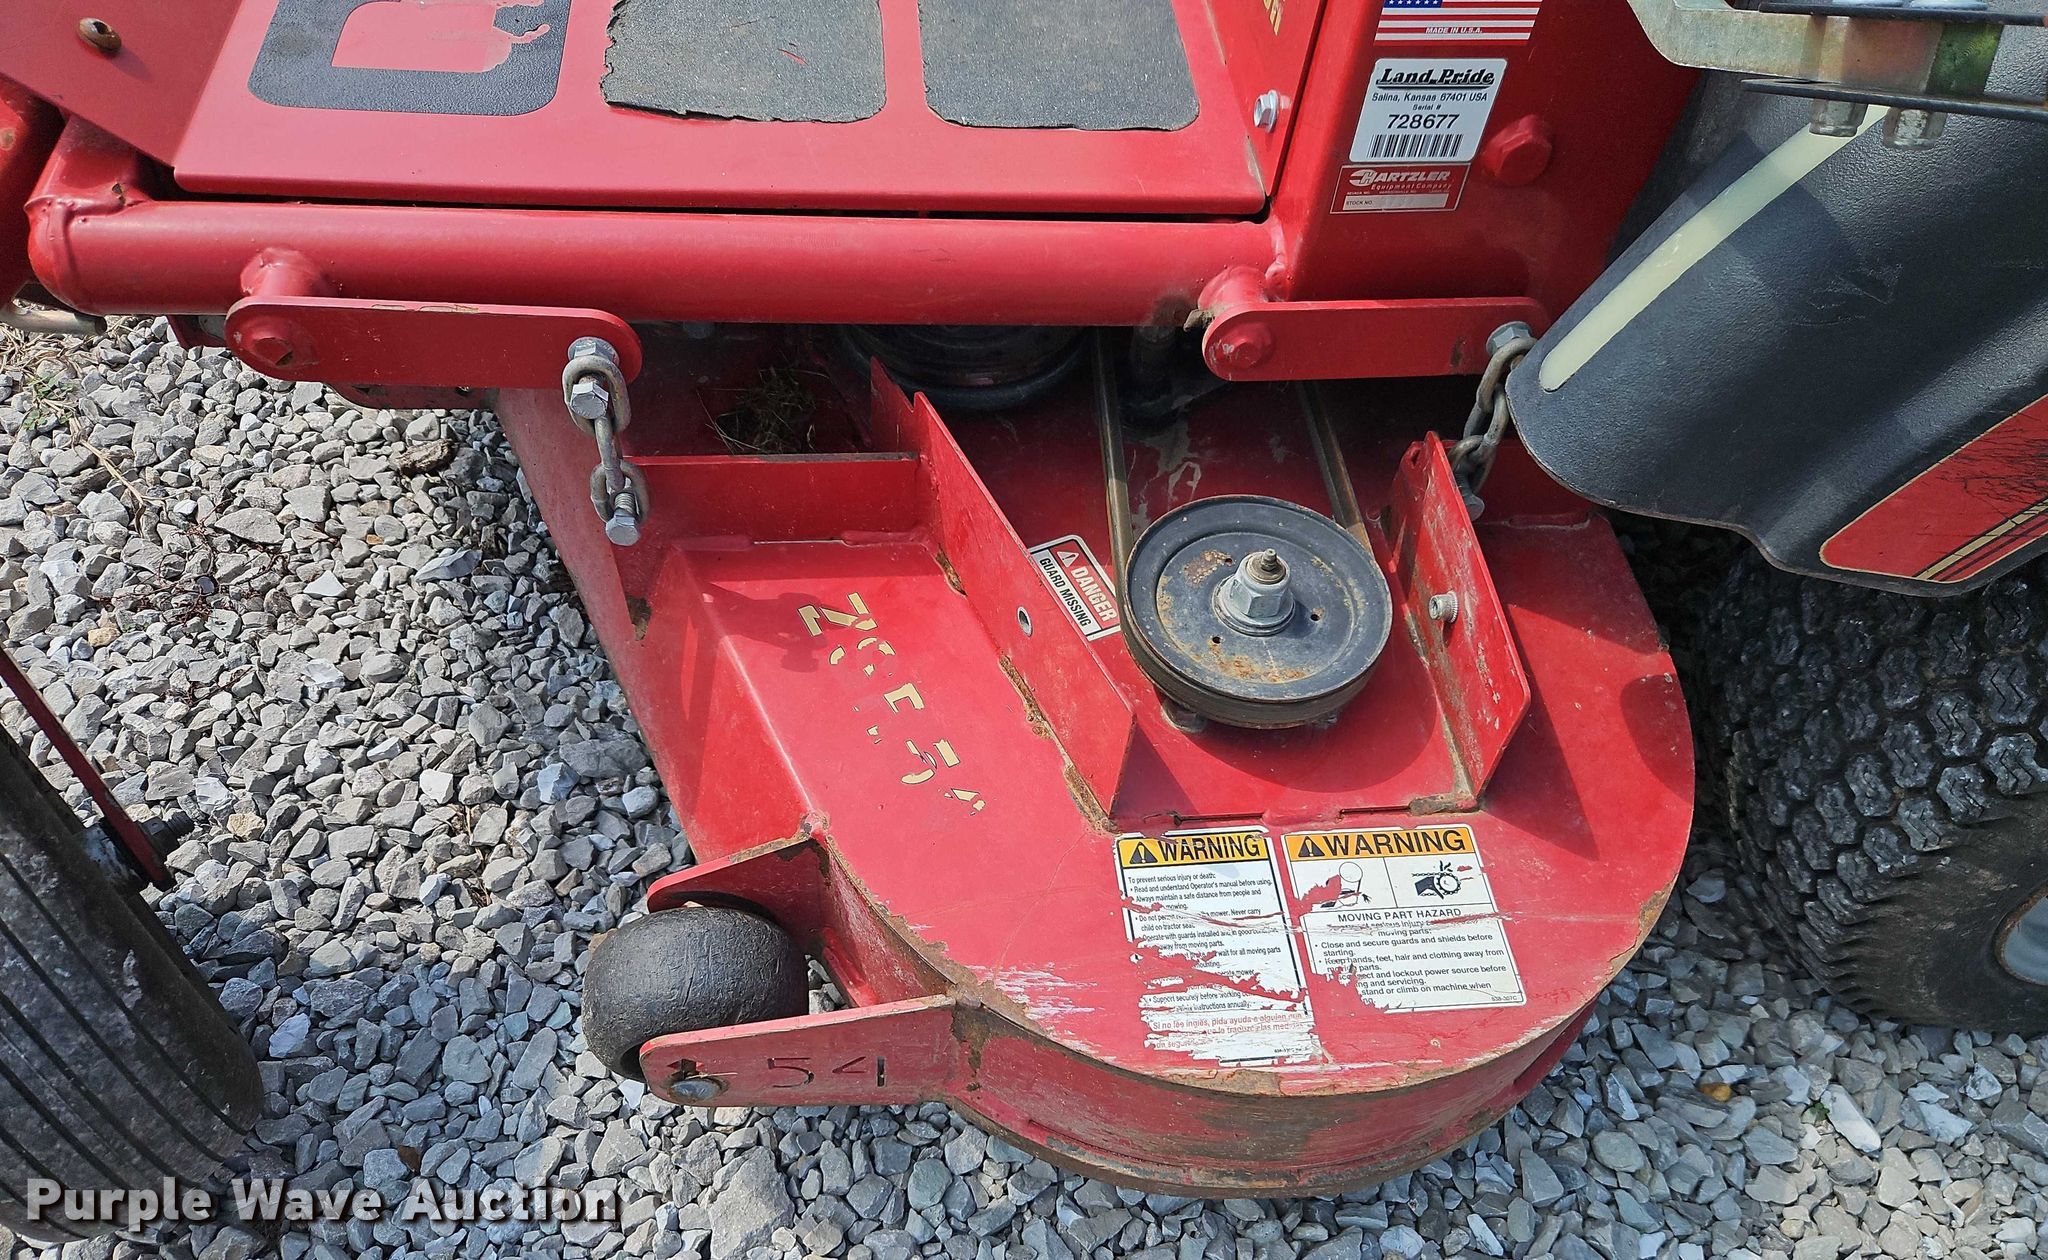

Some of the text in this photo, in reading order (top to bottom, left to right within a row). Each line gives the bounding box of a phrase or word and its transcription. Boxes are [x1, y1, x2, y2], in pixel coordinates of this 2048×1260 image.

[1376, 68, 1495, 85] Land Pride
[1372, 92, 1488, 103] Salina, Kansas 67401 USA
[1387, 114, 1460, 129] 728677
[1358, 170, 1451, 185] HARTZLER
[1040, 558, 1092, 626] GUARD MISSING
[1070, 566, 1118, 622] DANGER
[1158, 834, 1261, 862] WARNING
[1322, 830, 1466, 857] WARNING
[1136, 875, 1156, 885] prevent
[1157, 874, 1176, 882] serious
[1176, 872, 1192, 882] injury
[1199, 872, 1216, 880] death:
[1160, 882, 1190, 892] understand
[1190, 882, 1218, 890] Operator's
[1218, 880, 1238, 888] manual
[1238, 878, 1256, 887] before
[1257, 878, 1272, 888] using.
[1136, 894, 1154, 904] Always
[1156, 892, 1178, 902] maintain
[1184, 892, 1195, 900] safe
[1196, 890, 1218, 900] distance
[1219, 890, 1232, 898] from
[1232, 889, 1250, 898] people
[1251, 888, 1261, 896] and
[1247, 908, 1261, 916] carry
[1338, 908, 1462, 922] MOVING PART HAZARD
[1141, 924, 1154, 932] child
[1163, 922, 1179, 930] tractor
[1378, 927, 1432, 938] moving parts:
[1165, 932, 1177, 940] with
[1178, 932, 1196, 940] guards
[1196, 930, 1220, 938] installed
[1391, 938, 1419, 947] guards
[1437, 935, 1466, 943] shields
[1467, 934, 1493, 942] before
[1174, 942, 1187, 950] from
[1188, 940, 1208, 950] moving
[1209, 939, 1224, 948] parts.
[1246, 948, 1266, 956] moving
[1267, 946, 1281, 954] parts
[1323, 950, 1356, 958] starting.
[1348, 956, 1375, 965] hands,
[1429, 951, 1462, 960] clothing
[1485, 949, 1505, 957] from
[1359, 964, 1382, 973] parts.
[1393, 969, 1423, 978] lockout
[1424, 968, 1449, 977] power
[1480, 965, 1506, 973] before
[1387, 977, 1427, 986] servicing.
[1397, 986, 1419, 994] climb
[1433, 982, 1468, 992] machine
[1468, 982, 1492, 990] when
[1153, 994, 1175, 1004] Support
[1200, 992, 1218, 1001] before
[1153, 1021, 1161, 1030] Si
[1162, 1021, 1172, 1029] no
[1212, 1018, 1229, 1028] pida
[1230, 1016, 1251, 1027] ayuda
